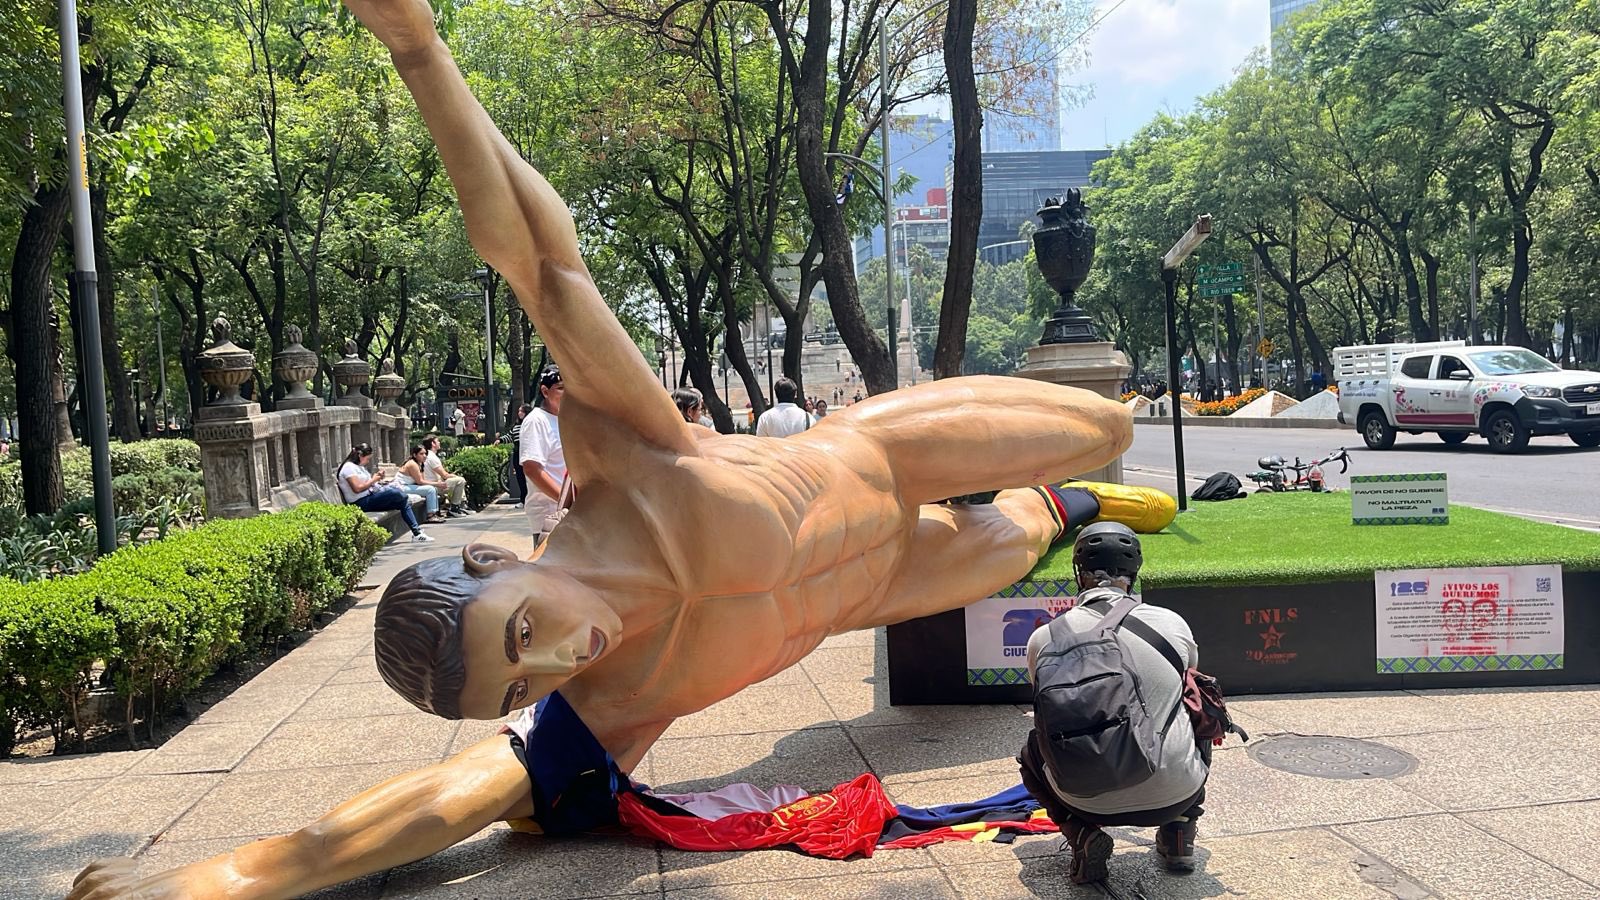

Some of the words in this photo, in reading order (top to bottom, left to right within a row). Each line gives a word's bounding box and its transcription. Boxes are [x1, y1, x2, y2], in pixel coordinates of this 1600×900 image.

[448, 387, 487, 399] CDMX
[1443, 583, 1478, 591] ¡VIVOS
[1481, 583, 1500, 591] LOS
[1244, 607, 1299, 625] FNLS
